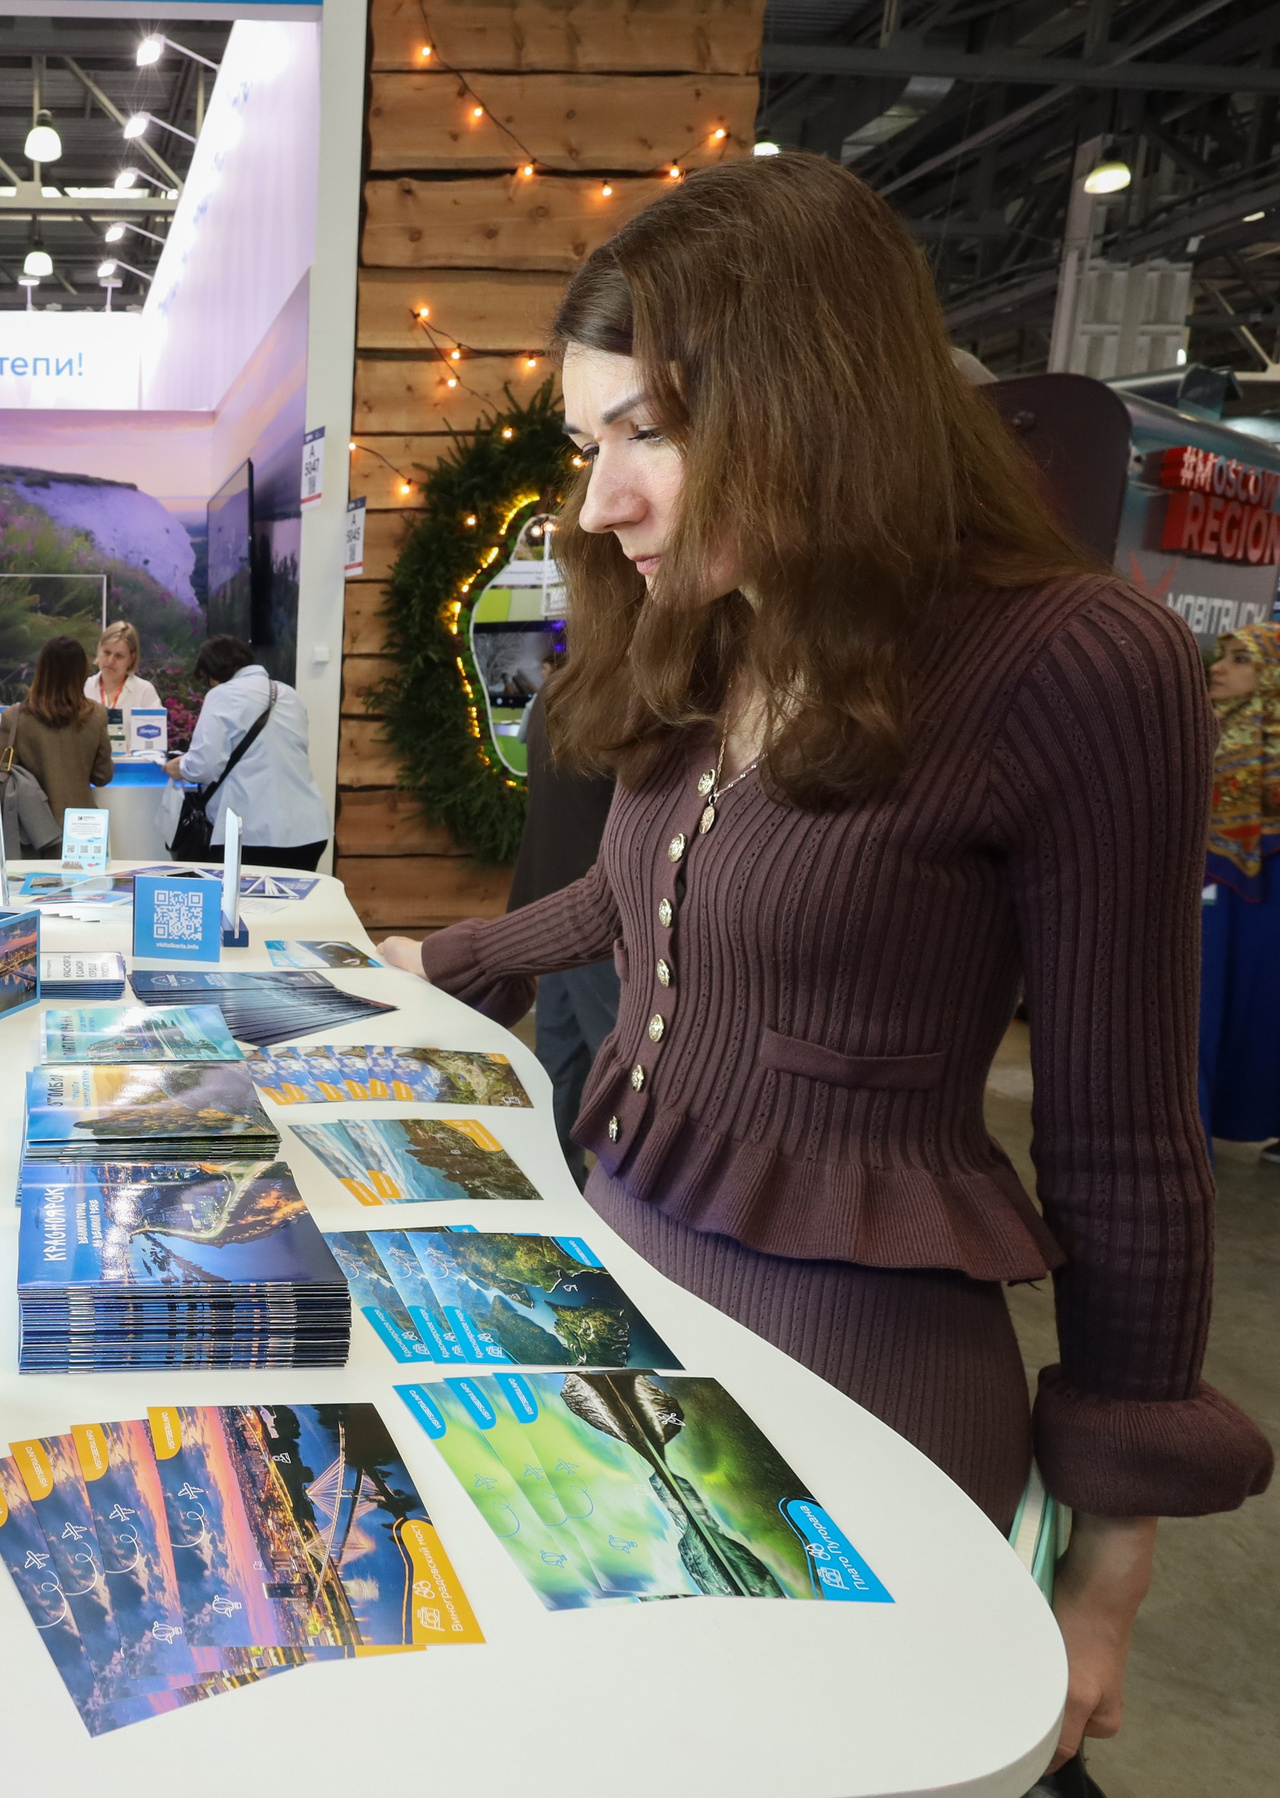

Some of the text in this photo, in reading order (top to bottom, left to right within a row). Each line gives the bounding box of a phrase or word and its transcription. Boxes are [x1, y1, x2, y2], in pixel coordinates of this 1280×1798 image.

[1181, 492, 1280, 566] REGION
[155, 941, 200, 951] visitsiberia.info
[43, 1187, 67, 1262] КРАСНОЯРСК
[410, 1523, 464, 1632] Виноградовский мост
[800, 1505, 870, 1590] Плато Путорана
